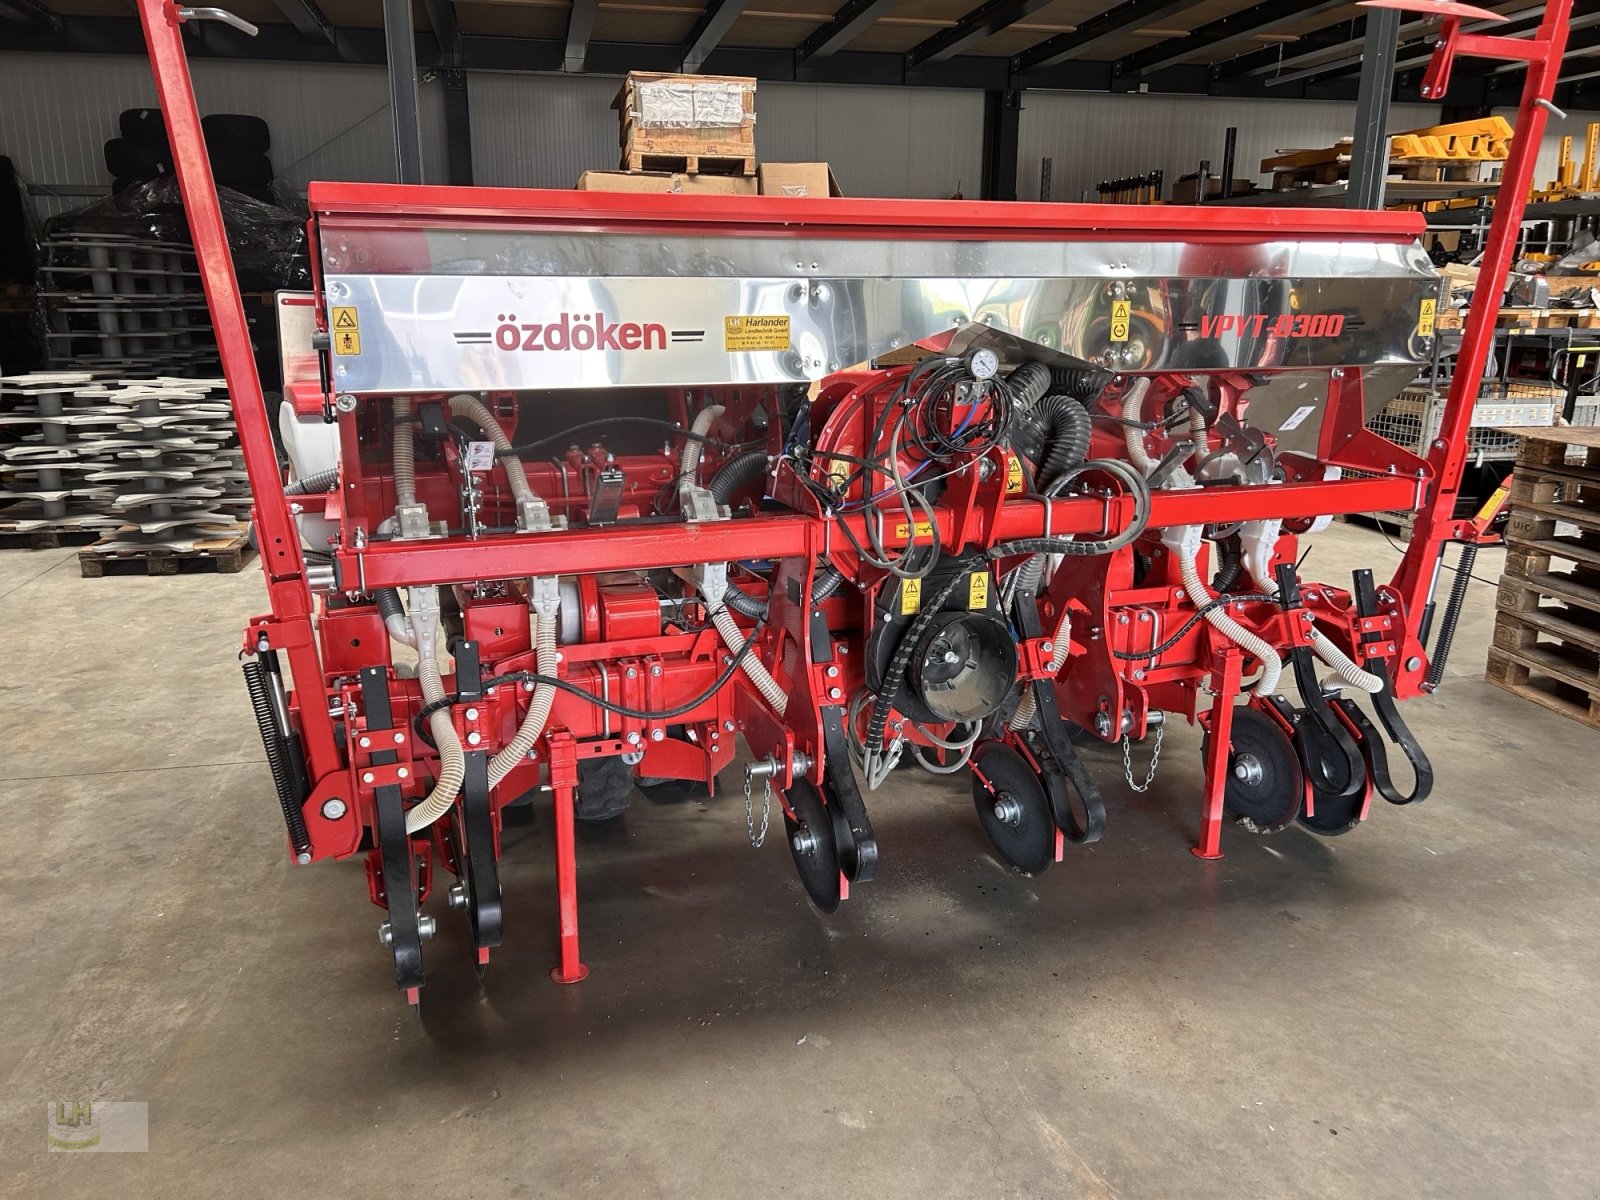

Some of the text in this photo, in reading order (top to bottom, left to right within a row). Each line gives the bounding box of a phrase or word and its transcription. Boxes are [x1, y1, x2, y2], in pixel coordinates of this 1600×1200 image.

[496, 312, 667, 351] özdöken
[745, 318, 789, 327] Harlander
[1200, 314, 1344, 338] VPYT-D300
